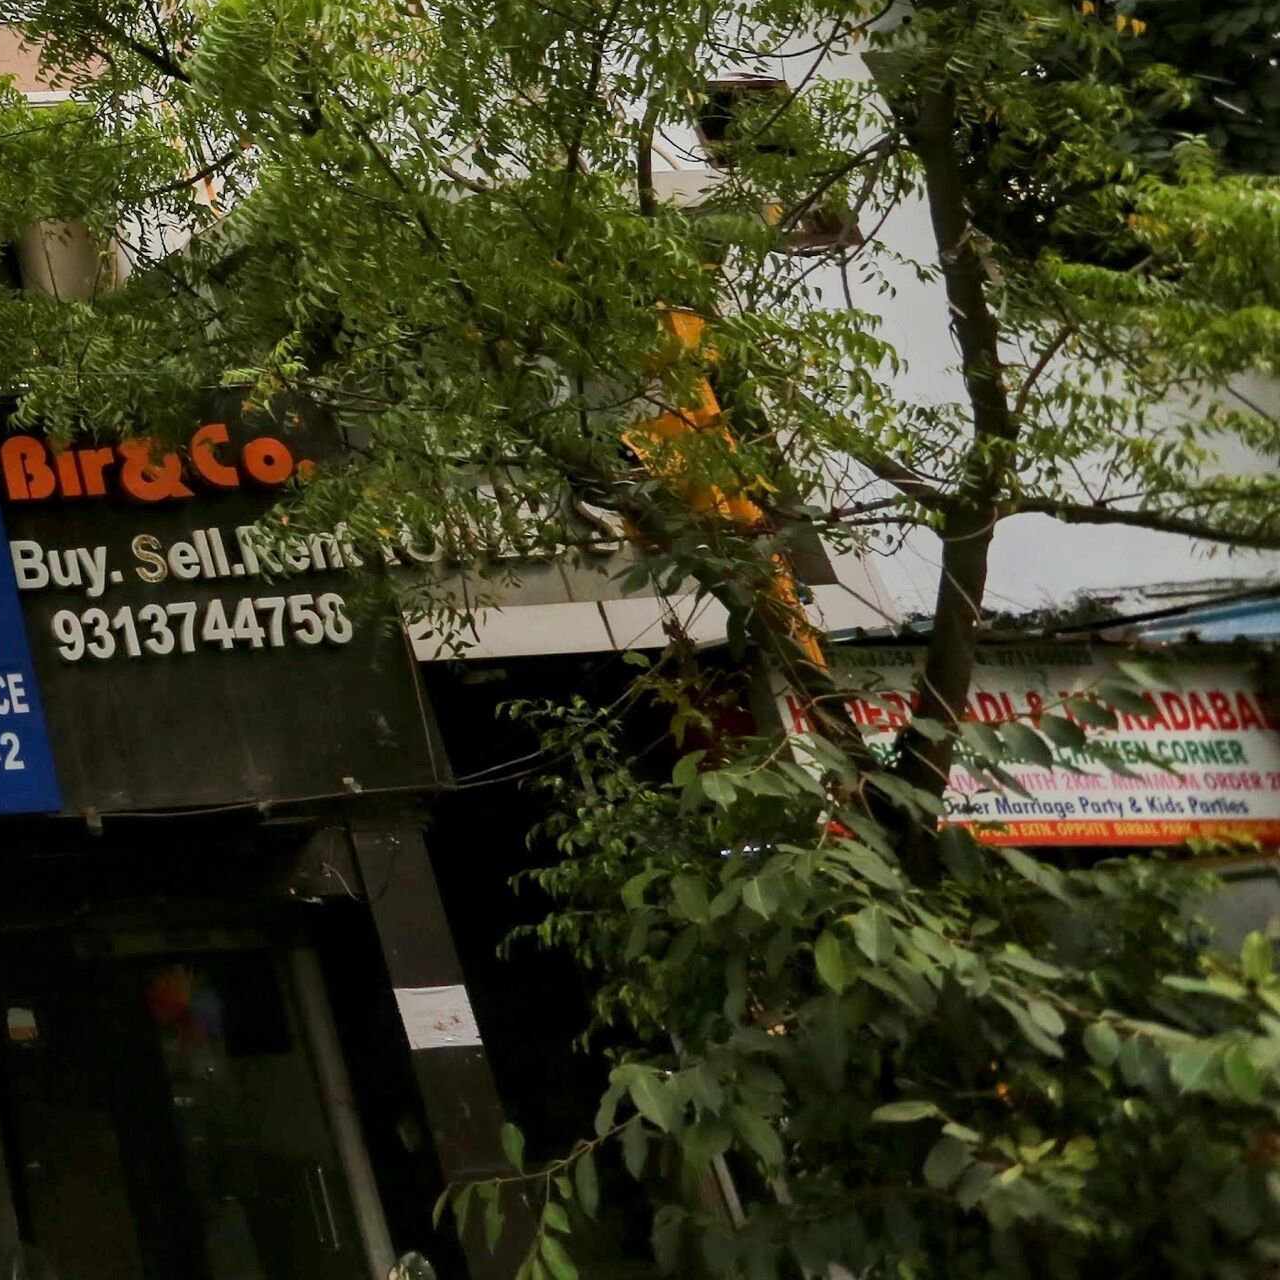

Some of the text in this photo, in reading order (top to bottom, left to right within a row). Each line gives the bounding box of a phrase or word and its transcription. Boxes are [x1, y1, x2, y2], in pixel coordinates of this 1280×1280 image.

[10, 539, 123, 598] Buy.
[51, 592, 354, 663] 9313744758
[1157, 738, 1248, 765] CORNER
[995, 794, 1075, 817] Marriage
[1078, 795, 1124, 817] Party
[1128, 797, 1142, 813] &
[1146, 794, 1185, 814] Kids
[1189, 793, 1250, 814] Parties
